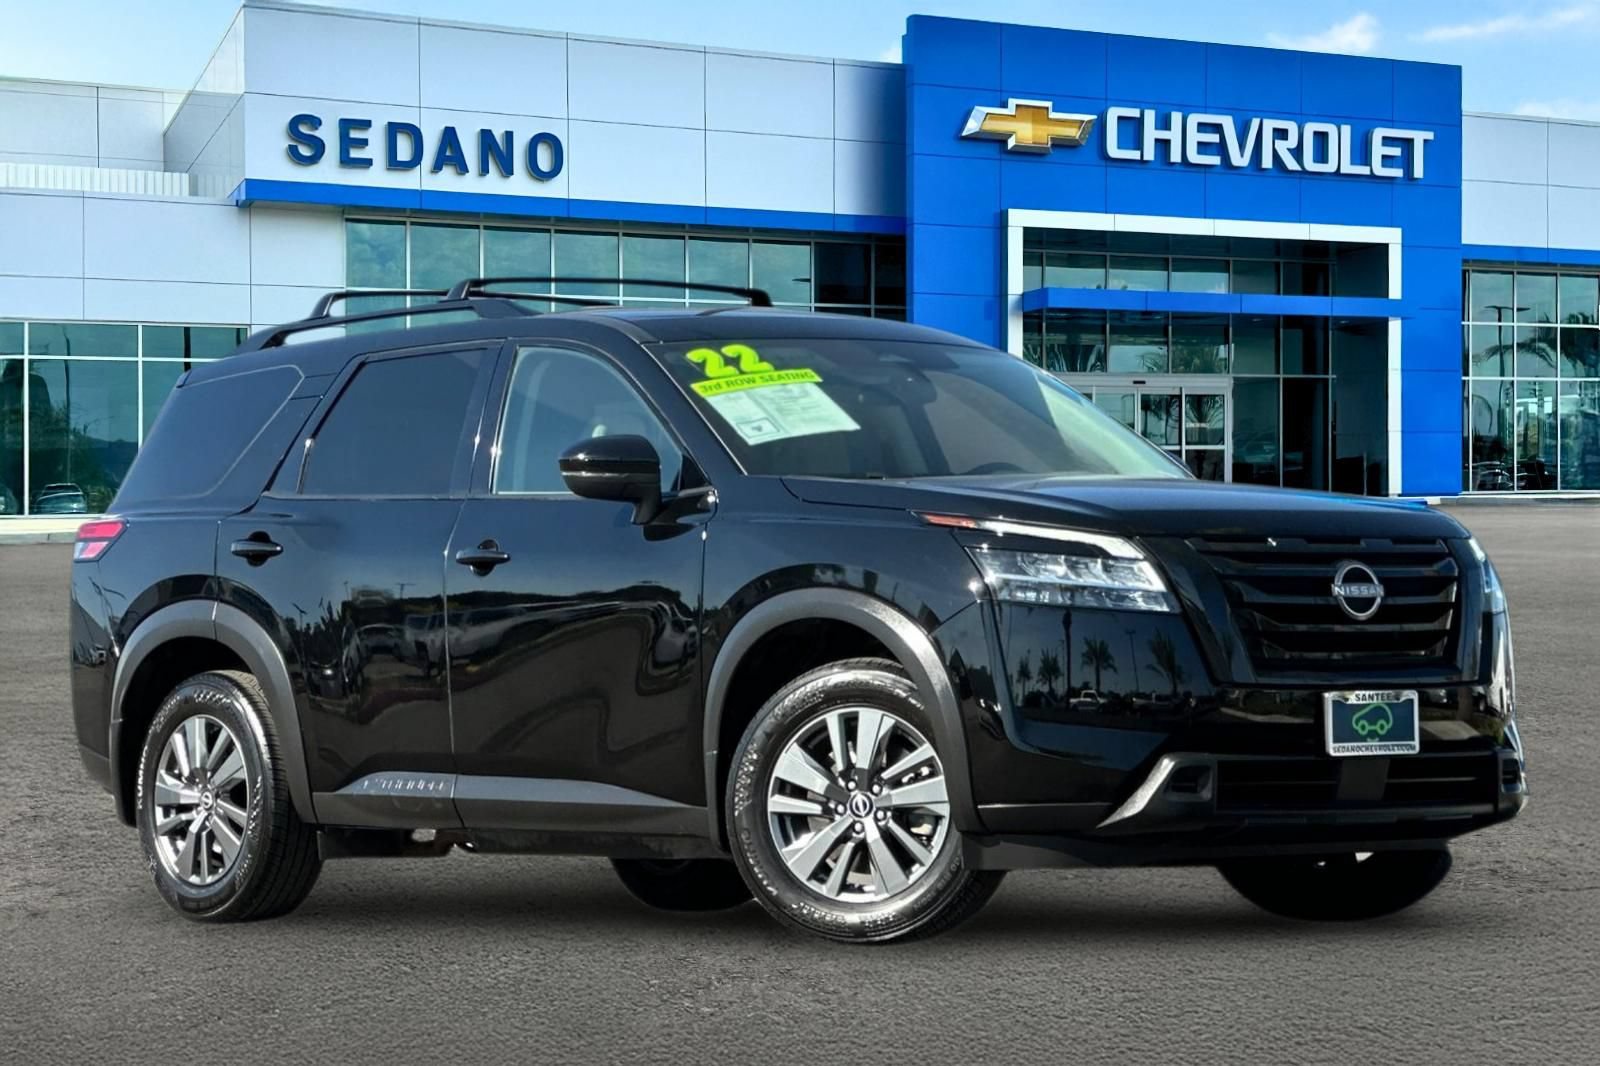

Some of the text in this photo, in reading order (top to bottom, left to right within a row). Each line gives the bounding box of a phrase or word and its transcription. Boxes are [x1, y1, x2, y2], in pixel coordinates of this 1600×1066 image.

[287, 113, 564, 181] SEDANO
[1106, 106, 1435, 179] CHEVROLET
[686, 344, 774, 377] 22
[725, 376, 757, 388] ROW
[760, 371, 816, 383] SEATING
[1334, 584, 1384, 596] NISSAN
